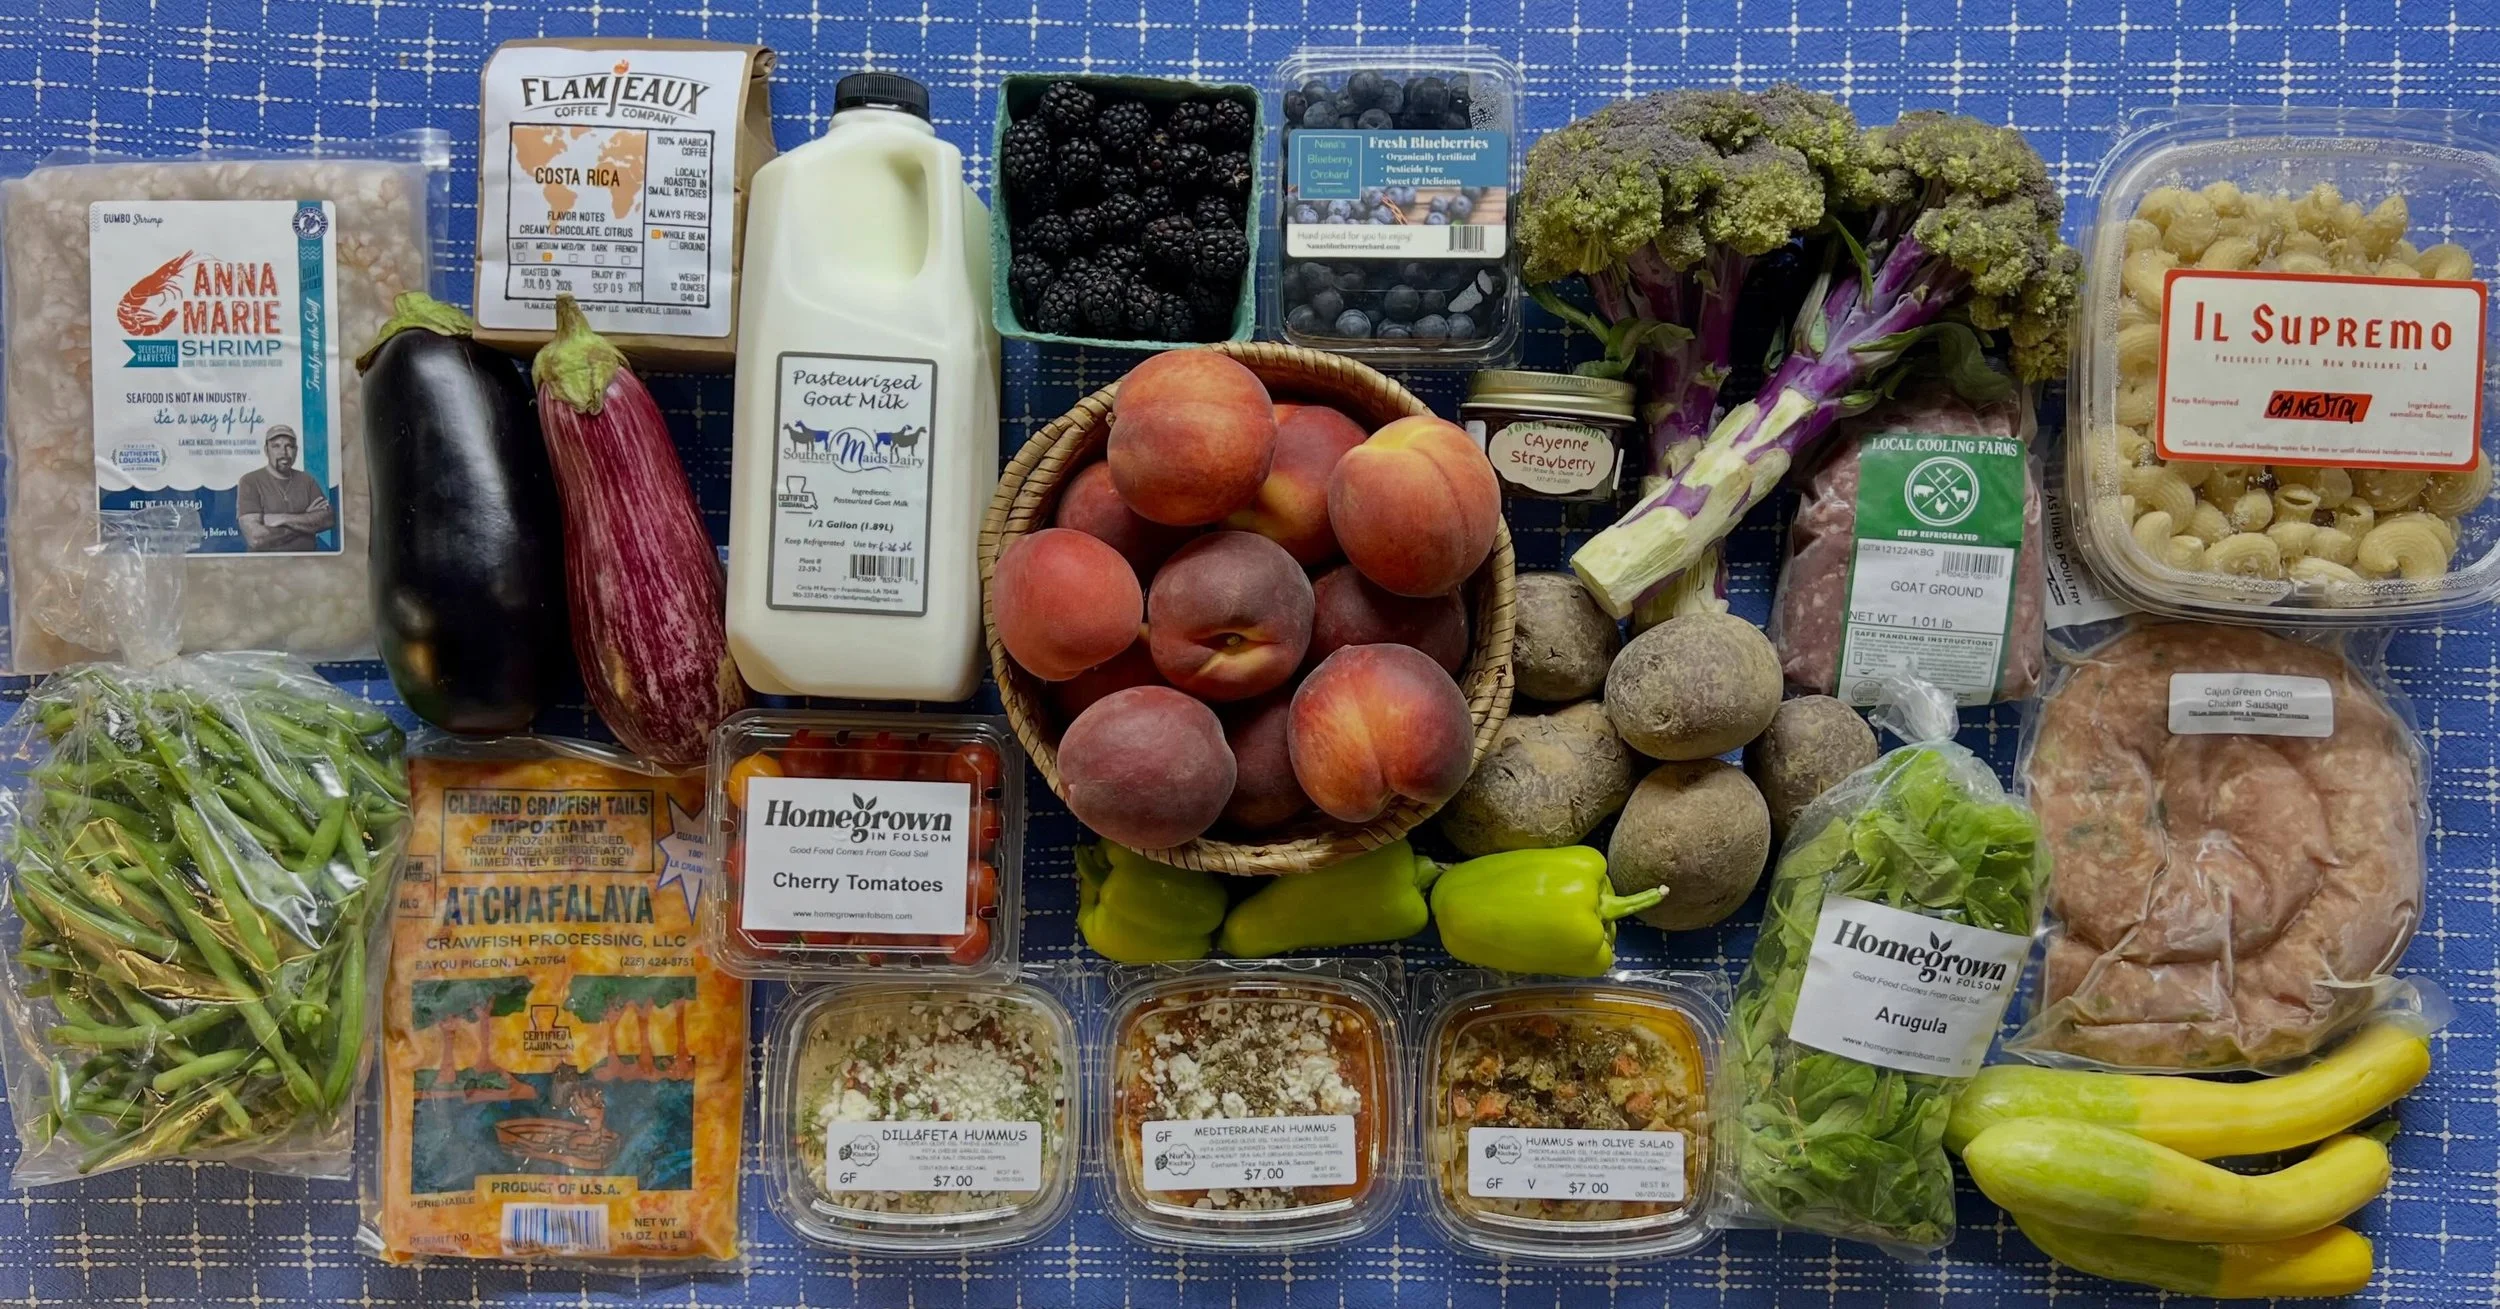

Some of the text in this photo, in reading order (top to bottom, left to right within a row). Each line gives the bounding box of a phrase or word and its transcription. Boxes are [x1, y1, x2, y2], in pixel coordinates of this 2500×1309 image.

[521, 75, 710, 118] FLAMJEAUX
[554, 106, 677, 126] COFFEE COMPANY
[657, 136, 708, 147] 100% ARABICA
[1369, 136, 1489, 149] Fresh Blueberries
[681, 147, 708, 157] COFFEE
[1386, 152, 1477, 163] Organically Fertilized
[1307, 154, 1353, 167] Blueberry
[675, 167, 707, 178] LOCALLY
[1310, 169, 1349, 180] Orchard
[1386, 165, 1444, 174] Pesticide Free
[535, 167, 620, 187] COSTA RICA
[664, 177, 696, 188] ROASTED
[1385, 177, 1461, 186] Sweet Delicious
[648, 186, 707, 199] SMALL BATCHES
[103, 213, 164, 227] GUMBO Shrimp
[547, 211, 605, 223] FLAVOR NOTES
[648, 208, 706, 221] ALWAYS FRESH
[604, 227, 633, 238] CITRUS
[662, 231, 706, 241] WHOLE BEAN
[1298, 231, 1346, 242] Hand picked
[615, 245, 638, 253] FRENCH
[680, 242, 706, 252] GROUND
[194, 262, 278, 296] ANNA
[679, 273, 705, 282] WEIGHT
[183, 300, 282, 335] MARIE
[182, 339, 282, 357] SHRIMP
[137, 353, 176, 362] HARVESTED
[793, 370, 922, 393] Pasteurized
[126, 392, 247, 404] SEAFOOD IS NOT AN INDUSTRY
[803, 391, 909, 410] Goat Milk
[2192, 397, 2239, 406] Refrigerated
[190, 414, 219, 432] way
[1872, 437, 2018, 457] LOCAL COOLING FARMS
[783, 447, 840, 463] Southern
[1511, 450, 1596, 476] Strawberry
[833, 496, 872, 505] Pasteurized
[808, 519, 894, 533] 1/2 Gallon (1.89L)
[784, 537, 845, 547] Keep Refrigerated
[1897, 529, 1979, 542] KEEP REFRIGERATED
[1890, 580, 1984, 598] GOAT GROUND
[1849, 610, 1936, 628] NET WT 1.01
[1854, 630, 1994, 646] SAFE HANDLING INSTRUCTIONS
[2204, 687, 2293, 698] Cajun Green Onion
[2208, 699, 2289, 710] Chicken Sausage
[448, 794, 649, 816] CLEANED CRAWFISH TAILS
[490, 819, 607, 834] IMPORTANT
[764, 799, 952, 844] Homegrown
[472, 834, 590, 846] KEEP FROZEN UNTIL
[871, 833, 951, 842] IN FOLSOM
[463, 846, 542, 856] THAW UNDER
[789, 846, 929, 858] Good Food Comes From Good Soil
[470, 856, 599, 867] IMMEDIATELY BEFORE
[773, 871, 944, 893] Cherry Tomatoes
[443, 884, 655, 926] ATCHAFALAYA
[426, 934, 522, 950] CRAWFISH
[653, 935, 687, 947] LLC
[1832, 919, 2007, 983] Homegrown
[415, 955, 566, 970] BAYOU LA 70764
[1852, 970, 1900, 989] Good Food
[1956, 977, 2001, 992] FOLSOM
[1875, 1006, 1948, 1034] Arugula
[523, 1031, 567, 1040] CERTIFIED
[523, 1041, 552, 1051] CAJUN
[882, 1129, 1028, 1141] DILL&FETA HUMMUS
[1155, 1130, 1173, 1142] GF
[1194, 1123, 1337, 1137] MEDITERRANEAN HUMMUS
[1526, 1138, 1674, 1149] HUMMUS with OLIVE SALAD
[839, 1172, 858, 1184] GF
[933, 1175, 973, 1187] $7.00
[1244, 1168, 1284, 1181] $7.00
[491, 1182, 621, 1195] PRODUCT OF U.S.A.
[1486, 1178, 1503, 1190] GF
[1568, 1181, 1609, 1195] $7.00
[634, 1218, 656, 1227] NET
